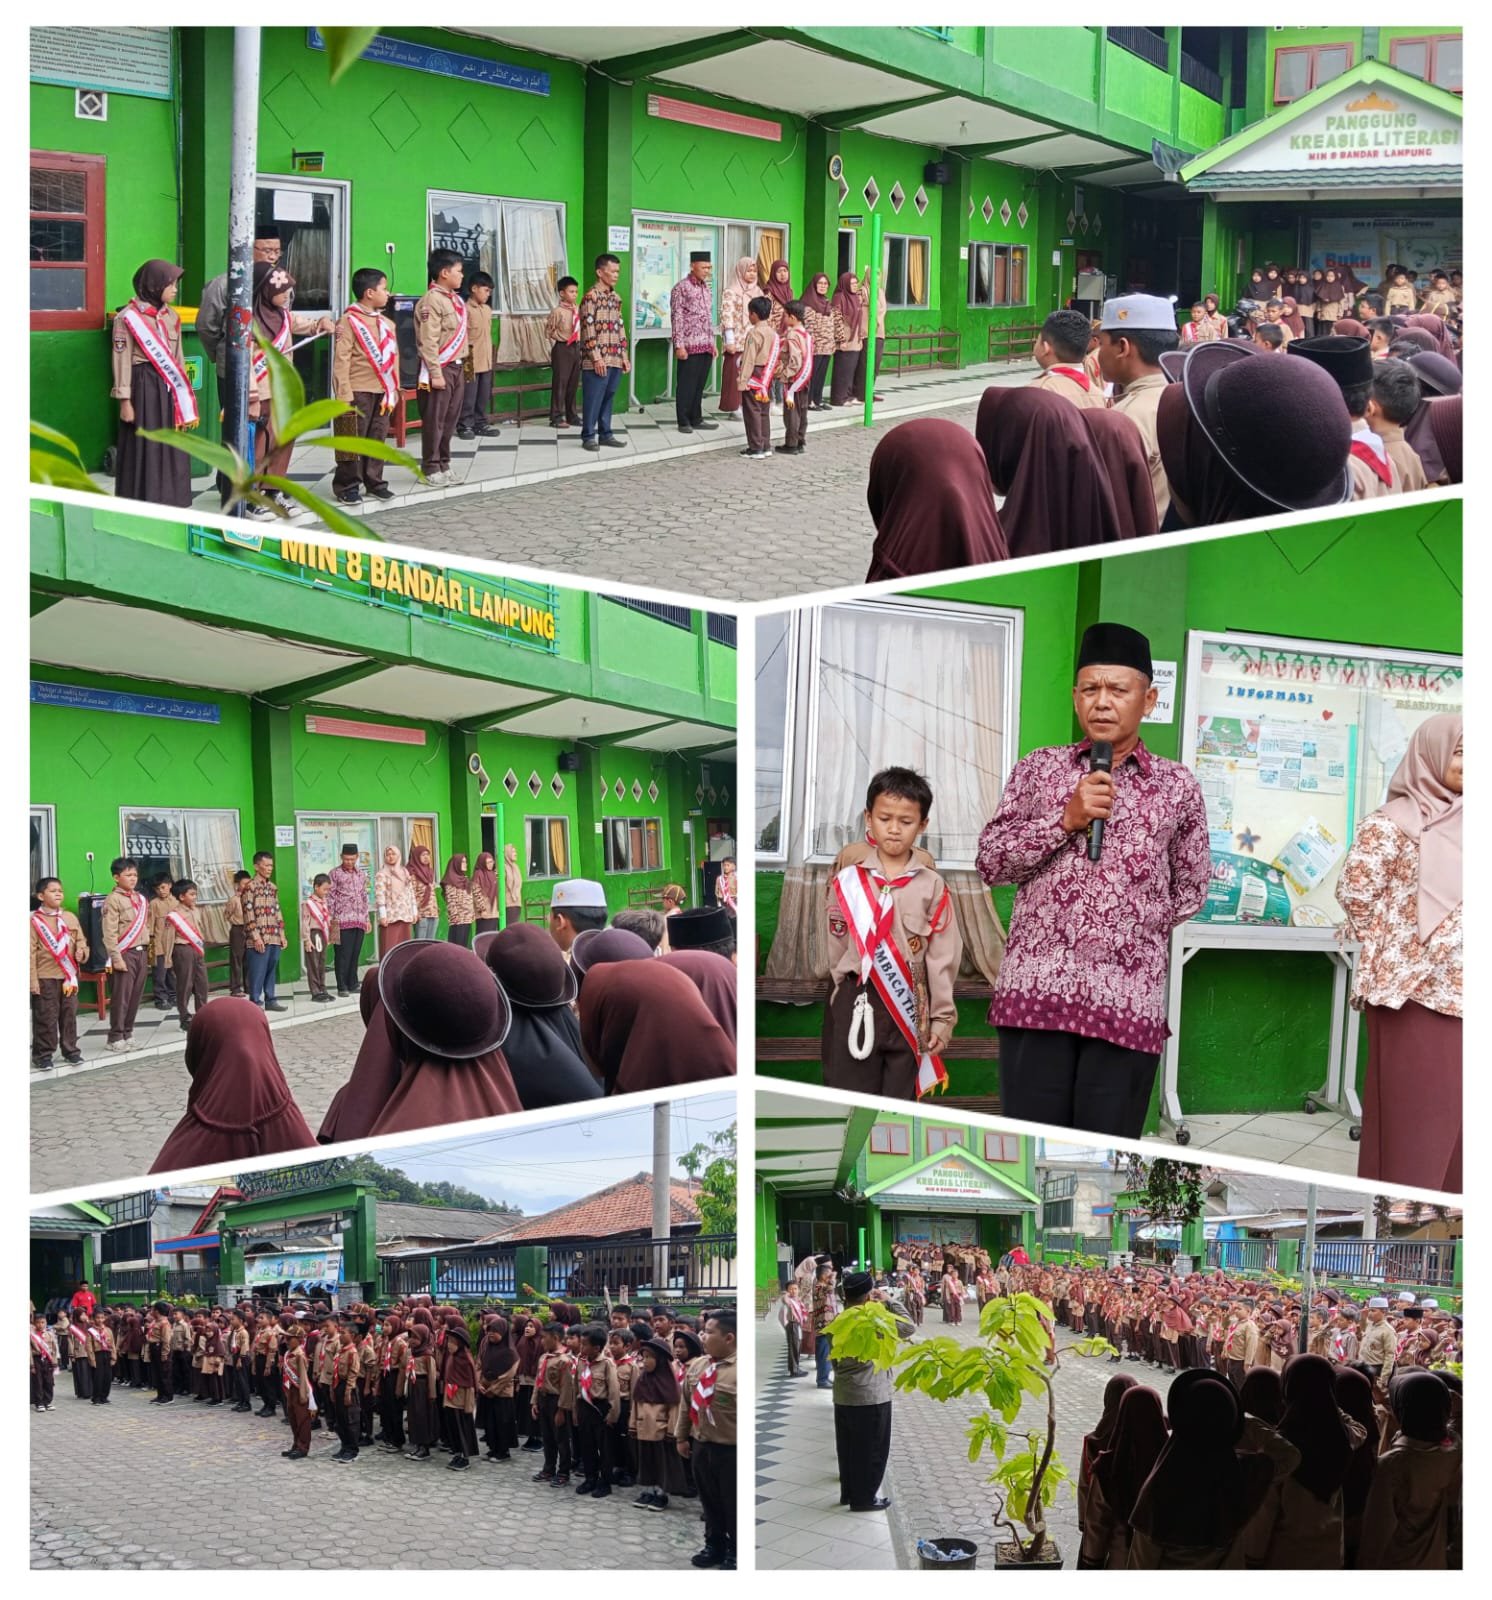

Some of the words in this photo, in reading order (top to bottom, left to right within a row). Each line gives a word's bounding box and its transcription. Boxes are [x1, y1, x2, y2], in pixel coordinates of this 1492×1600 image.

[1326, 112, 1417, 131] PANGGUNG
[1289, 133, 1355, 150] KREASI
[1373, 129, 1459, 147] LITERASI
[1308, 152, 1327, 160] MIN
[1339, 150, 1379, 159] BANDAR
[1384, 148, 1432, 158] LAMPUNG
[280, 538, 338, 576] MIN
[345, 549, 363, 582] 8
[370, 555, 465, 613] BANDAR
[468, 585, 556, 641] LAMPUNG
[1227, 685, 1314, 704] INFORMASI
[875, 943, 906, 998] MBACA
